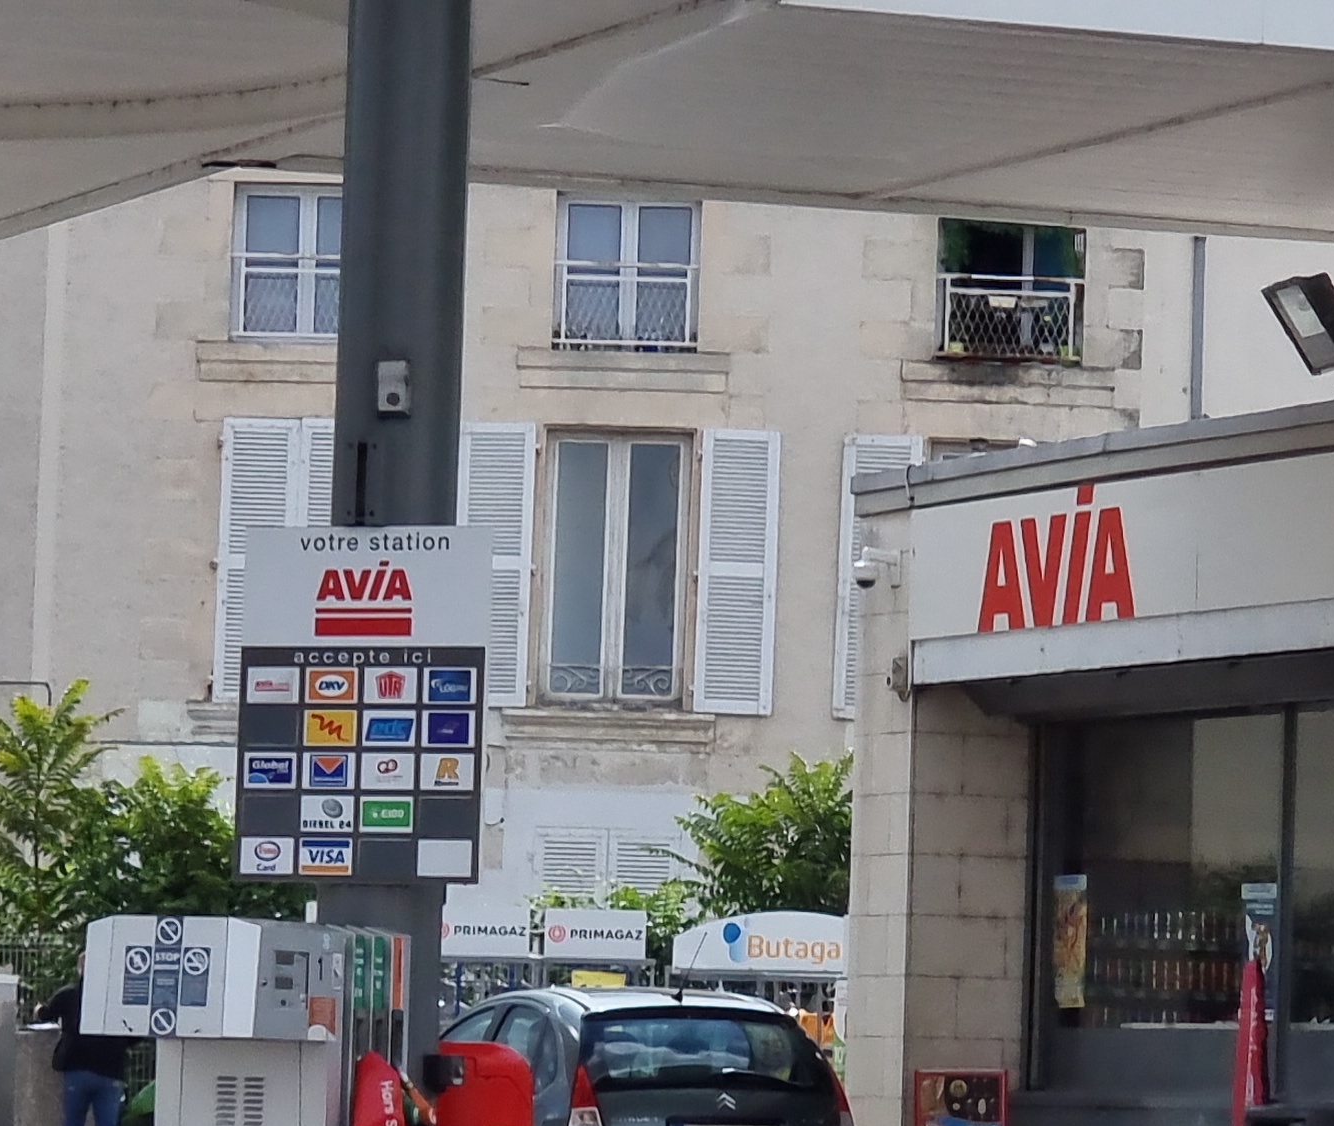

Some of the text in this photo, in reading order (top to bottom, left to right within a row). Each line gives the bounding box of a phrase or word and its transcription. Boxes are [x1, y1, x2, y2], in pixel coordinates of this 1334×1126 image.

[300, 531, 450, 551] votre station
[293, 648, 432, 666] accepte ici
[318, 679, 345, 692] DKV
[302, 820, 352, 829] DIESEL 24
[308, 850, 345, 864] VISA
[453, 925, 527, 937] PRIMAGAZ
[570, 928, 644, 941] PRIMAGAZ
[317, 957, 323, 981] 1
[380, 1080, 395, 1115] Hors
